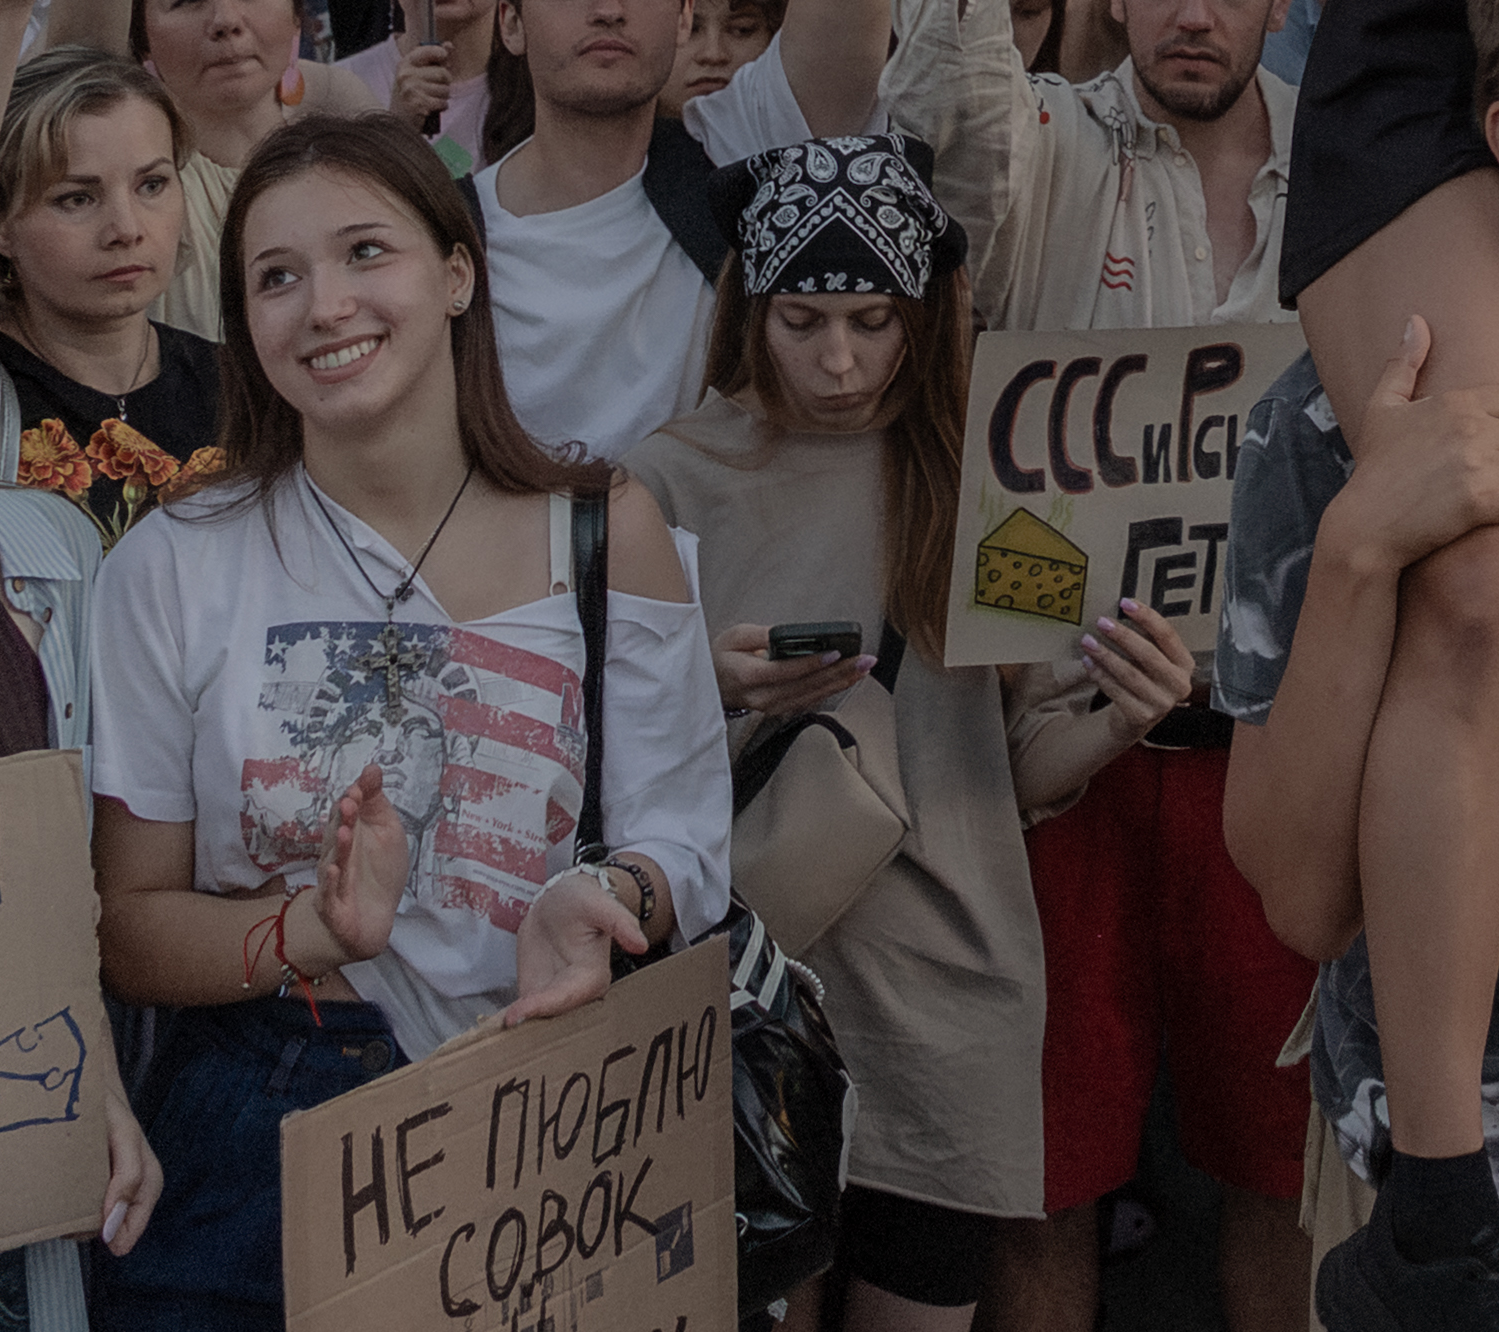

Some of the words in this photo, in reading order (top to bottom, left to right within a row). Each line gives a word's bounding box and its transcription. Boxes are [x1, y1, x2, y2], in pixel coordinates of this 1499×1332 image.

[460, 808, 482, 823] New
[492, 817, 514, 834] York
[338, 1101, 456, 1279] НЕ
[438, 1156, 662, 1319] СОВОК
